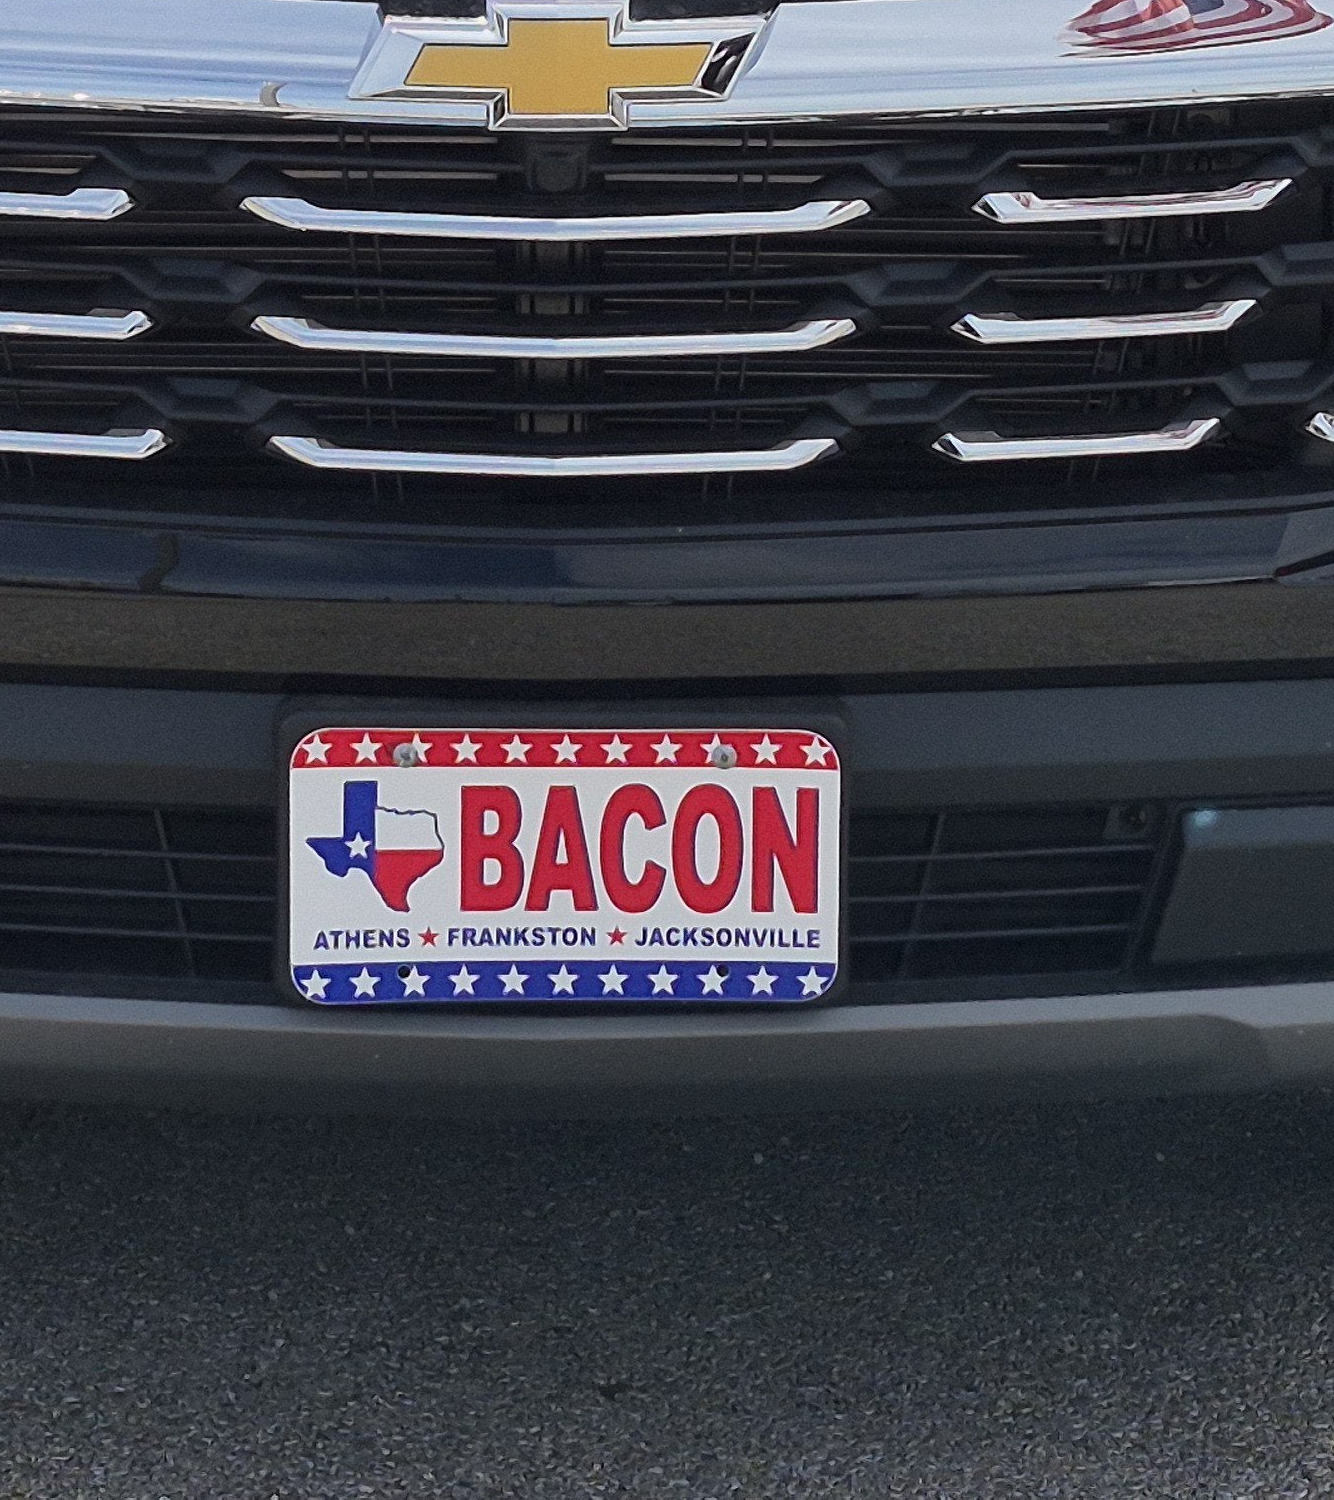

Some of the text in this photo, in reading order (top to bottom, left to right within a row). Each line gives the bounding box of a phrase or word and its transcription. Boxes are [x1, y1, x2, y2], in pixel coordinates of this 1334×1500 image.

[459, 782, 820, 914] BACON
[313, 926, 821, 950] ATHENS FRANKSTON JACKSONVILLE
